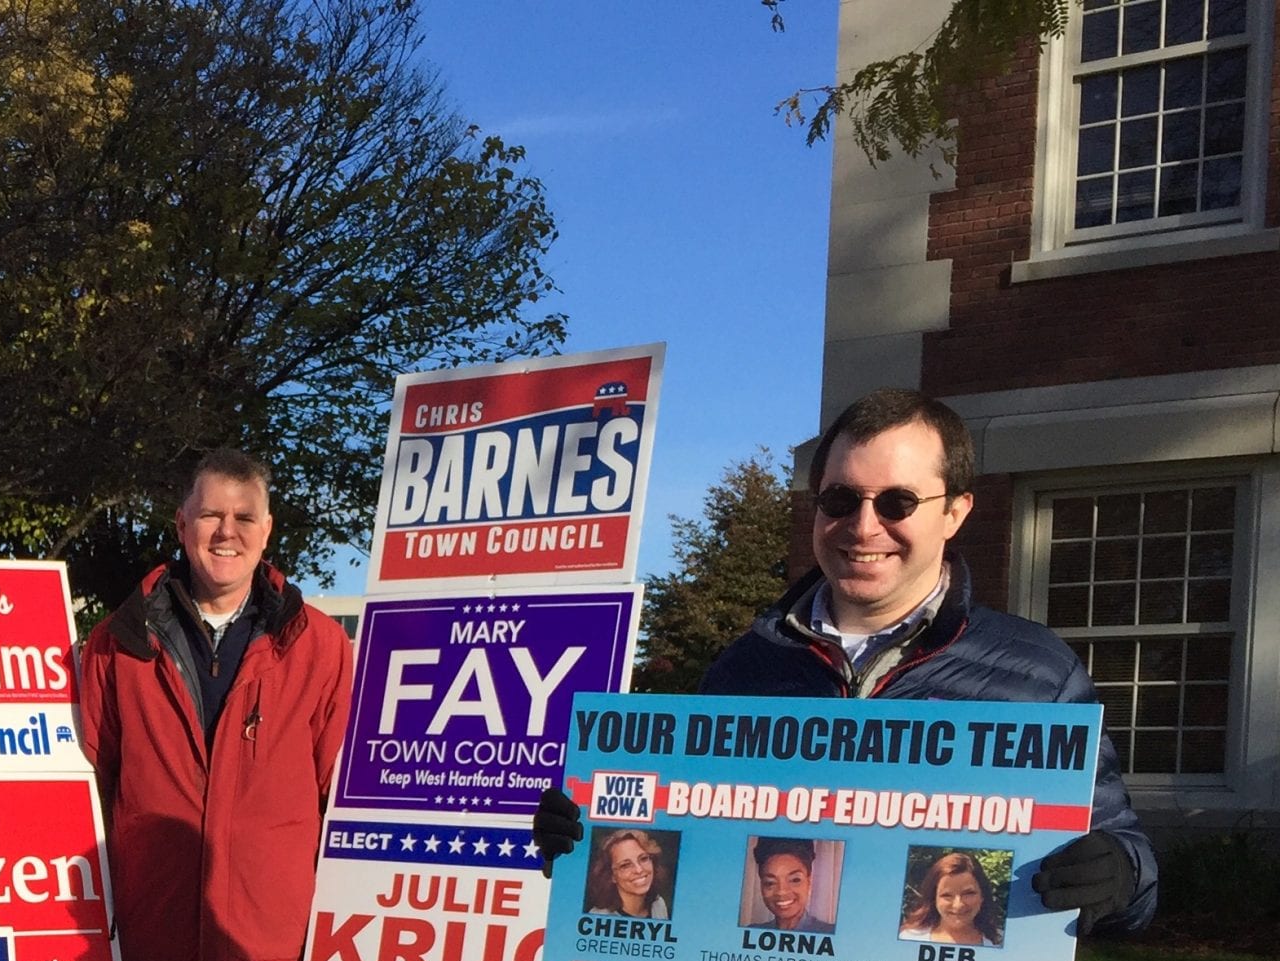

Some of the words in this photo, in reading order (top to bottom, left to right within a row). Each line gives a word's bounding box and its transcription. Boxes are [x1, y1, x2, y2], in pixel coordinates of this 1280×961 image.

[415, 402, 483, 429] CHRIS
[389, 416, 640, 526] BARNES
[404, 530, 477, 560] TOWN
[487, 522, 604, 554] COUNCIL
[449, 620, 526, 645] MARY
[378, 646, 588, 737] FAY
[366, 740, 447, 764] TOWN
[575, 710, 679, 756] YOUR
[685, 715, 955, 767] DEMOCRATIC
[968, 722, 1089, 771] TEAM
[379, 768, 412, 790] Keep
[415, 769, 446, 786] West
[448, 769, 505, 788] Hartford
[507, 772, 552, 792] Strong
[605, 776, 645, 797] VOTE
[596, 796, 636, 816] ROW
[636, 799, 648, 817] A
[666, 781, 777, 822] BOARD
[786, 787, 828, 824] OF
[833, 789, 1033, 834] EDUCATION
[328, 831, 393, 851] ELECT
[375, 873, 524, 917] JULIE
[578, 916, 678, 943] CHERYL
[576, 939, 675, 959] GREENBERG
[742, 930, 835, 957] LORNA
